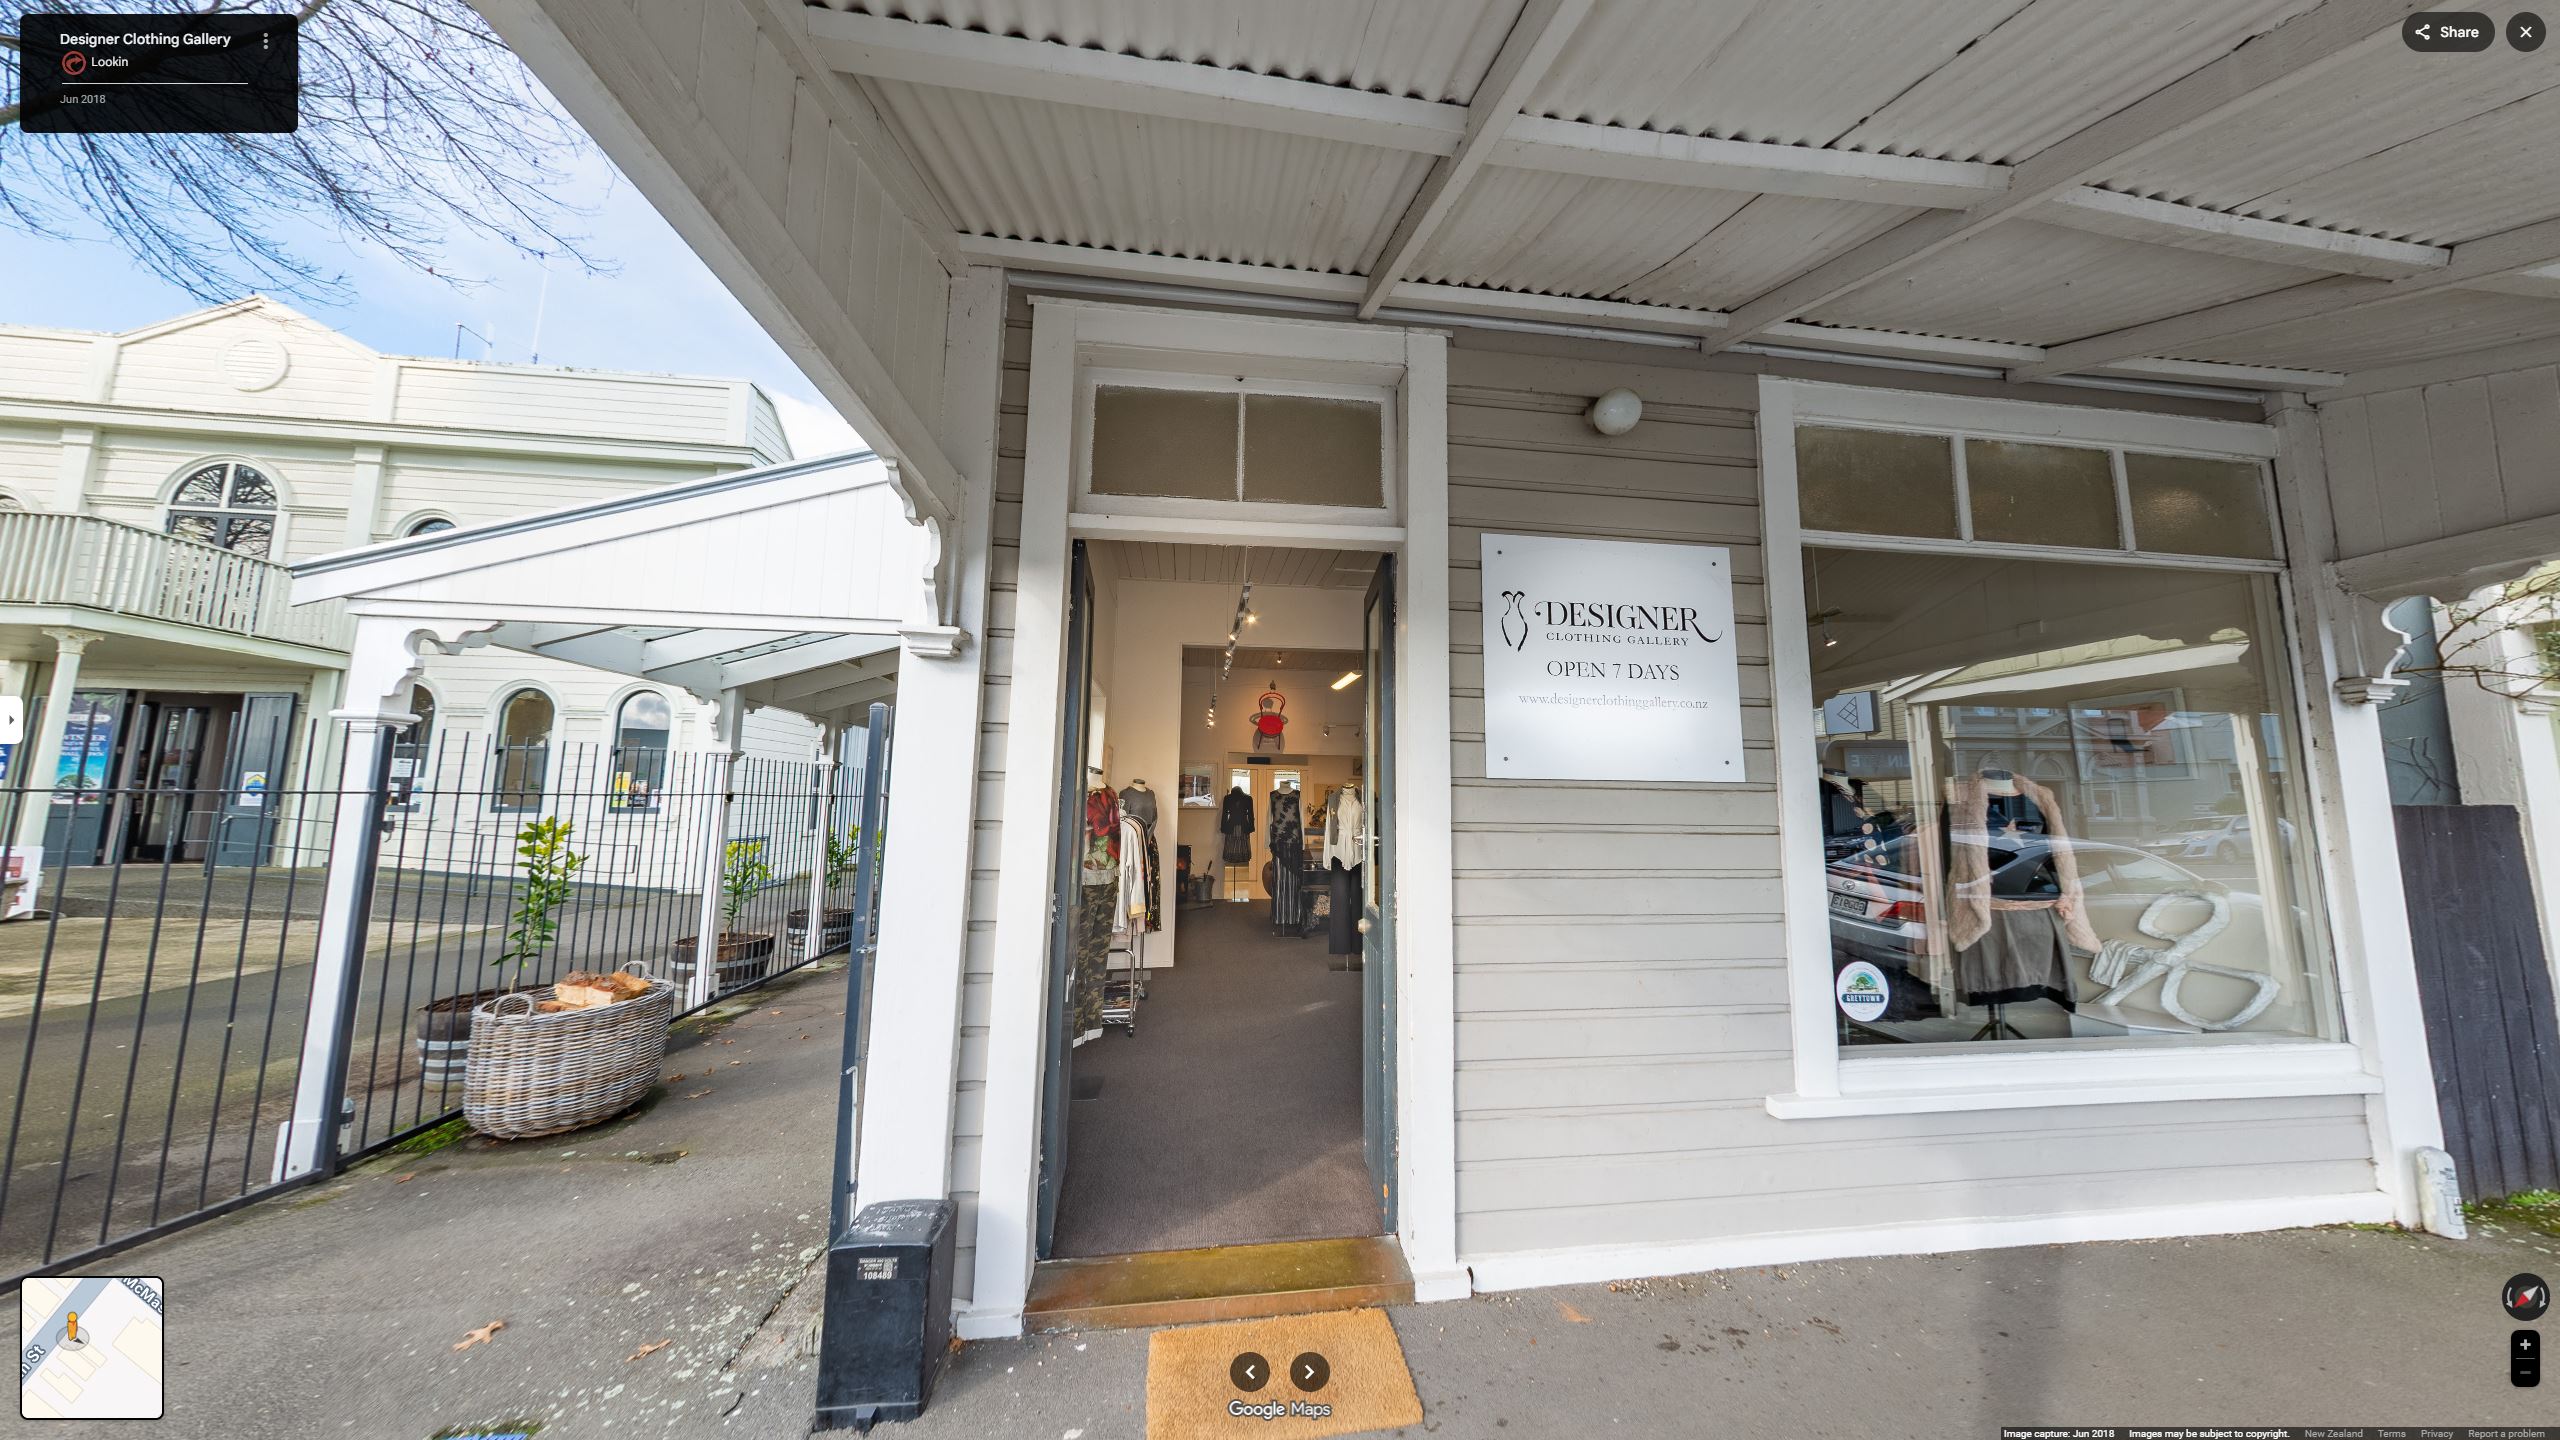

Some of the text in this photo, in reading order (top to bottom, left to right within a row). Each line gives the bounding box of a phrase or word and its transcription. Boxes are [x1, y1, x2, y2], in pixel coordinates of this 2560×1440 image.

[1535, 601, 1723, 643] DESIGNER
[1546, 632, 1689, 646] CLOTHING GALLERY
[1547, 660, 1680, 681] OPEN 7 DAYS
[1518, 692, 1709, 711] www.designerclothinggallery.co.nz
[1846, 994, 1880, 1002] GREYTOWN
